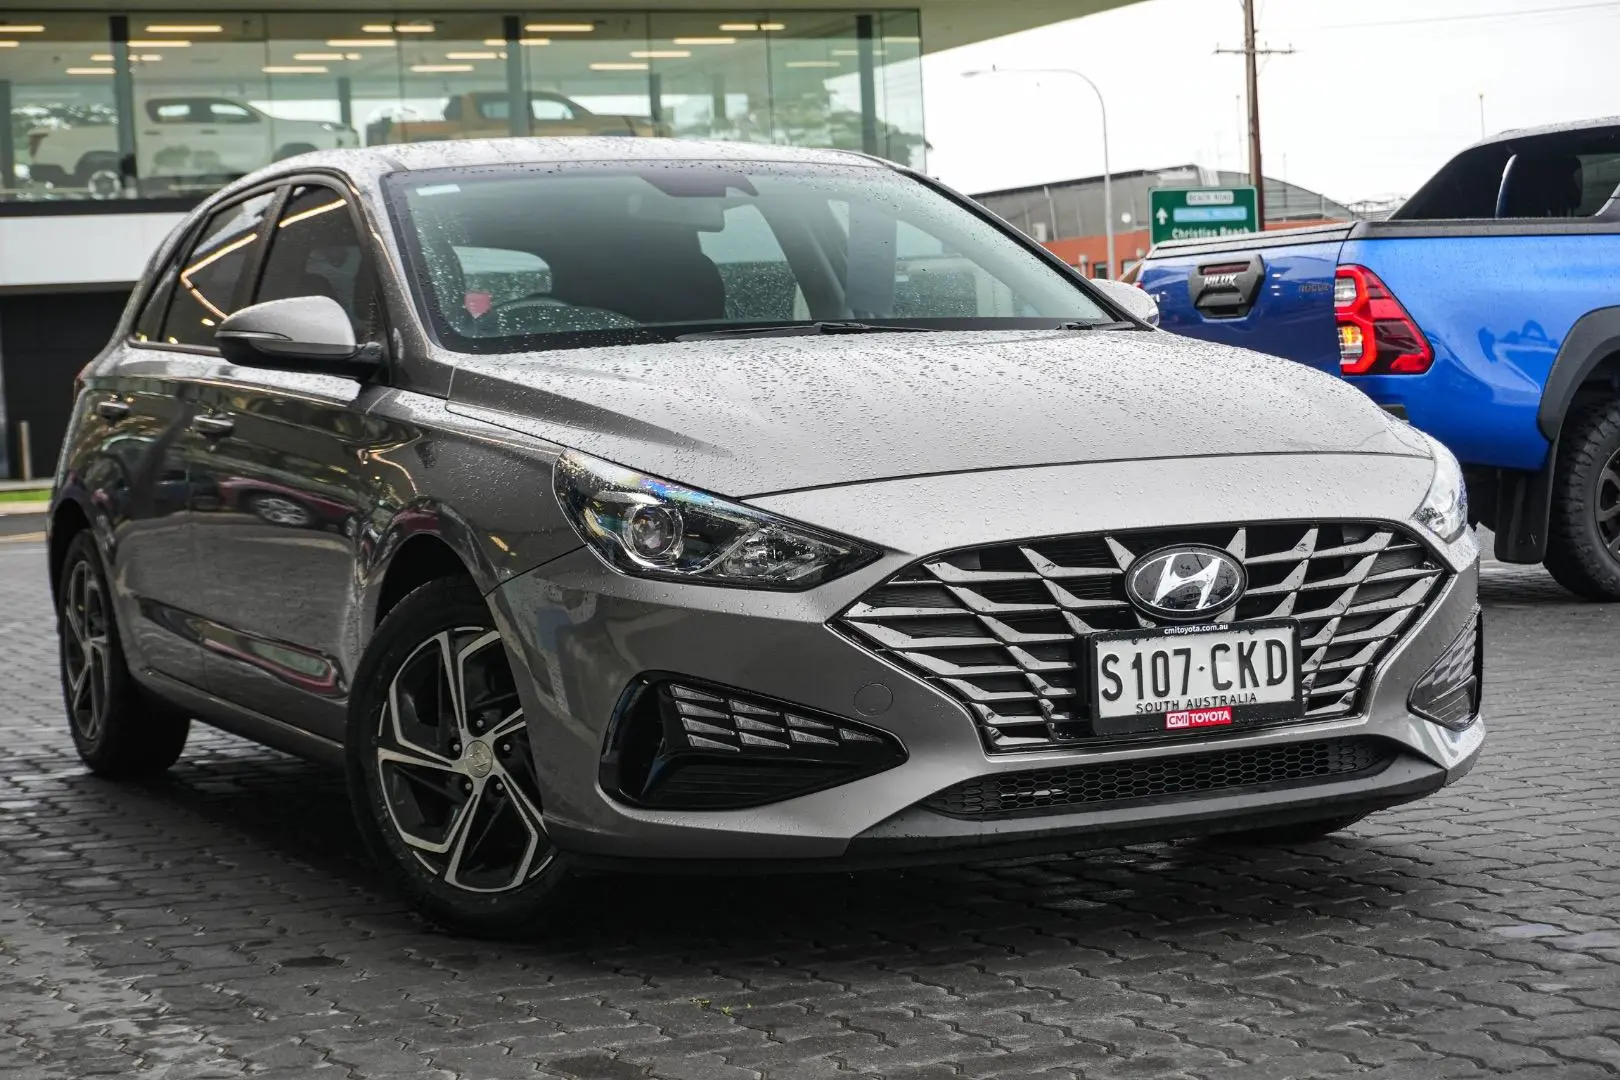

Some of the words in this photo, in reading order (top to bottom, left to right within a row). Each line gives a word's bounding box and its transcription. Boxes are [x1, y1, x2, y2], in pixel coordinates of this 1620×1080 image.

[1203, 274, 1238, 286] HILUX
[1164, 624, 1229, 635] cmitoyota.com.au
[1136, 700, 1180, 714] SOUTH
[1186, 693, 1258, 709] AUSTRALIA
[1168, 714, 1189, 728] CMI
[1190, 710, 1231, 724] TOYOTA
